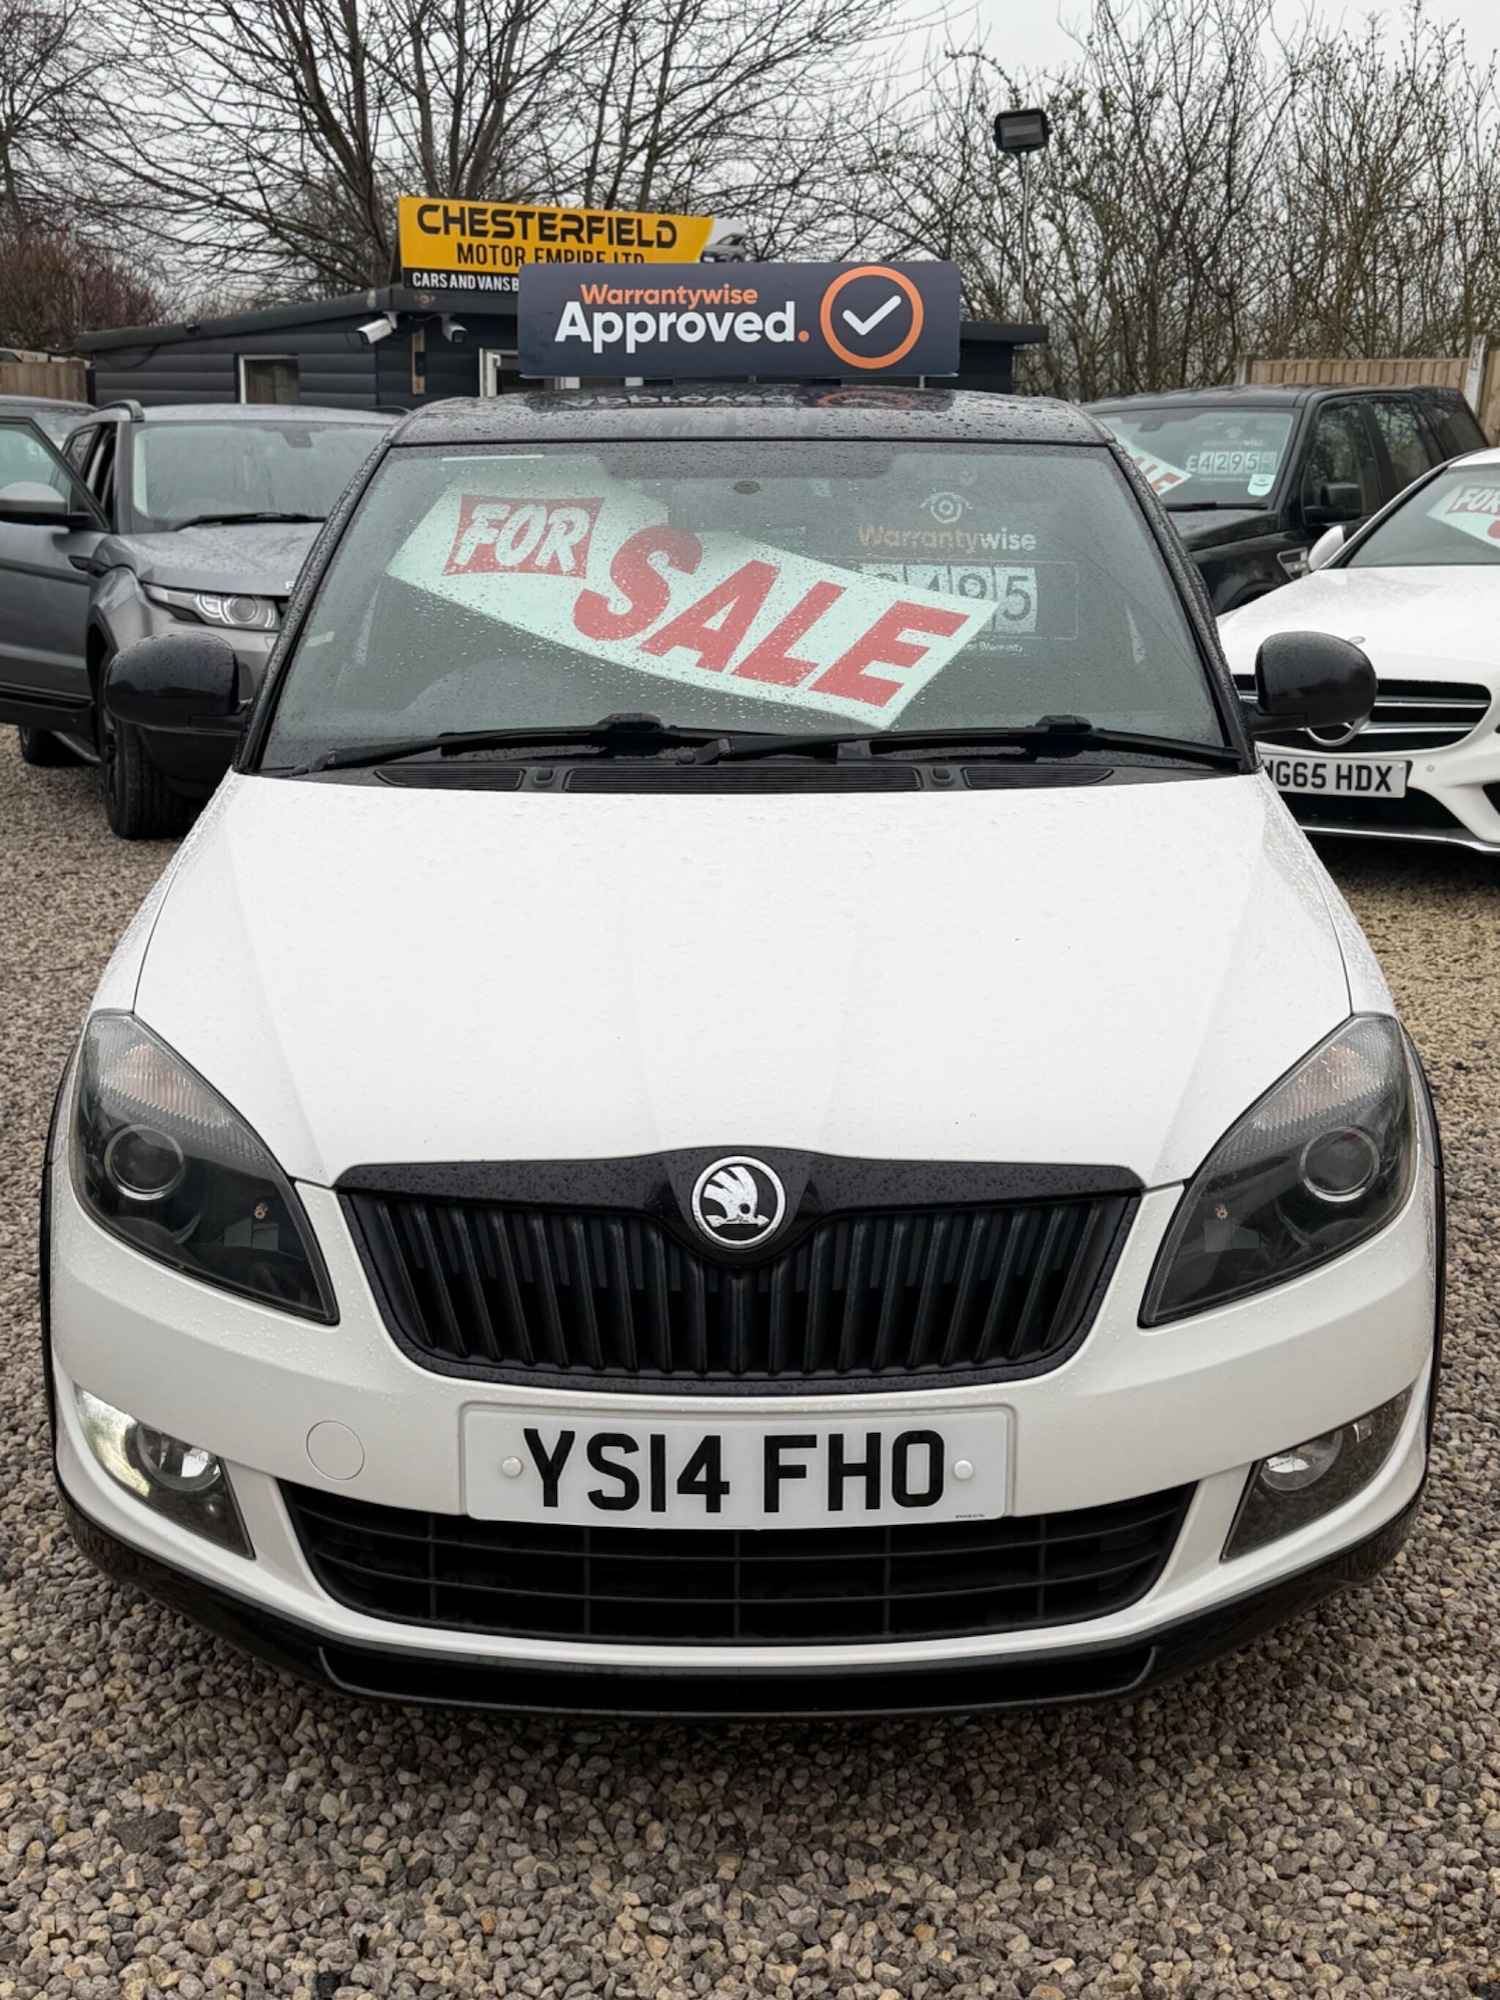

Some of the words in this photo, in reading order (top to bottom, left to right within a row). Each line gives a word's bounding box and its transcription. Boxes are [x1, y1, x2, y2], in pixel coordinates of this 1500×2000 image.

[417, 204, 677, 249] CHESTERFIELD
[456, 242, 526, 267] MOTOR
[412, 272, 448, 288] CARS
[449, 273, 476, 290] AND
[477, 274, 511, 291] VANS
[580, 283, 758, 310] Warrantywise
[554, 301, 810, 354] Approved.
[1186, 453, 1259, 472] £4295
[857, 526, 1037, 553] Warrantywise
[455, 502, 590, 571] FOR
[573, 524, 970, 708] SALE
[1336, 764, 1393, 792] HDX
[523, 1427, 730, 1513] YS14
[763, 1429, 945, 1513] FHO
